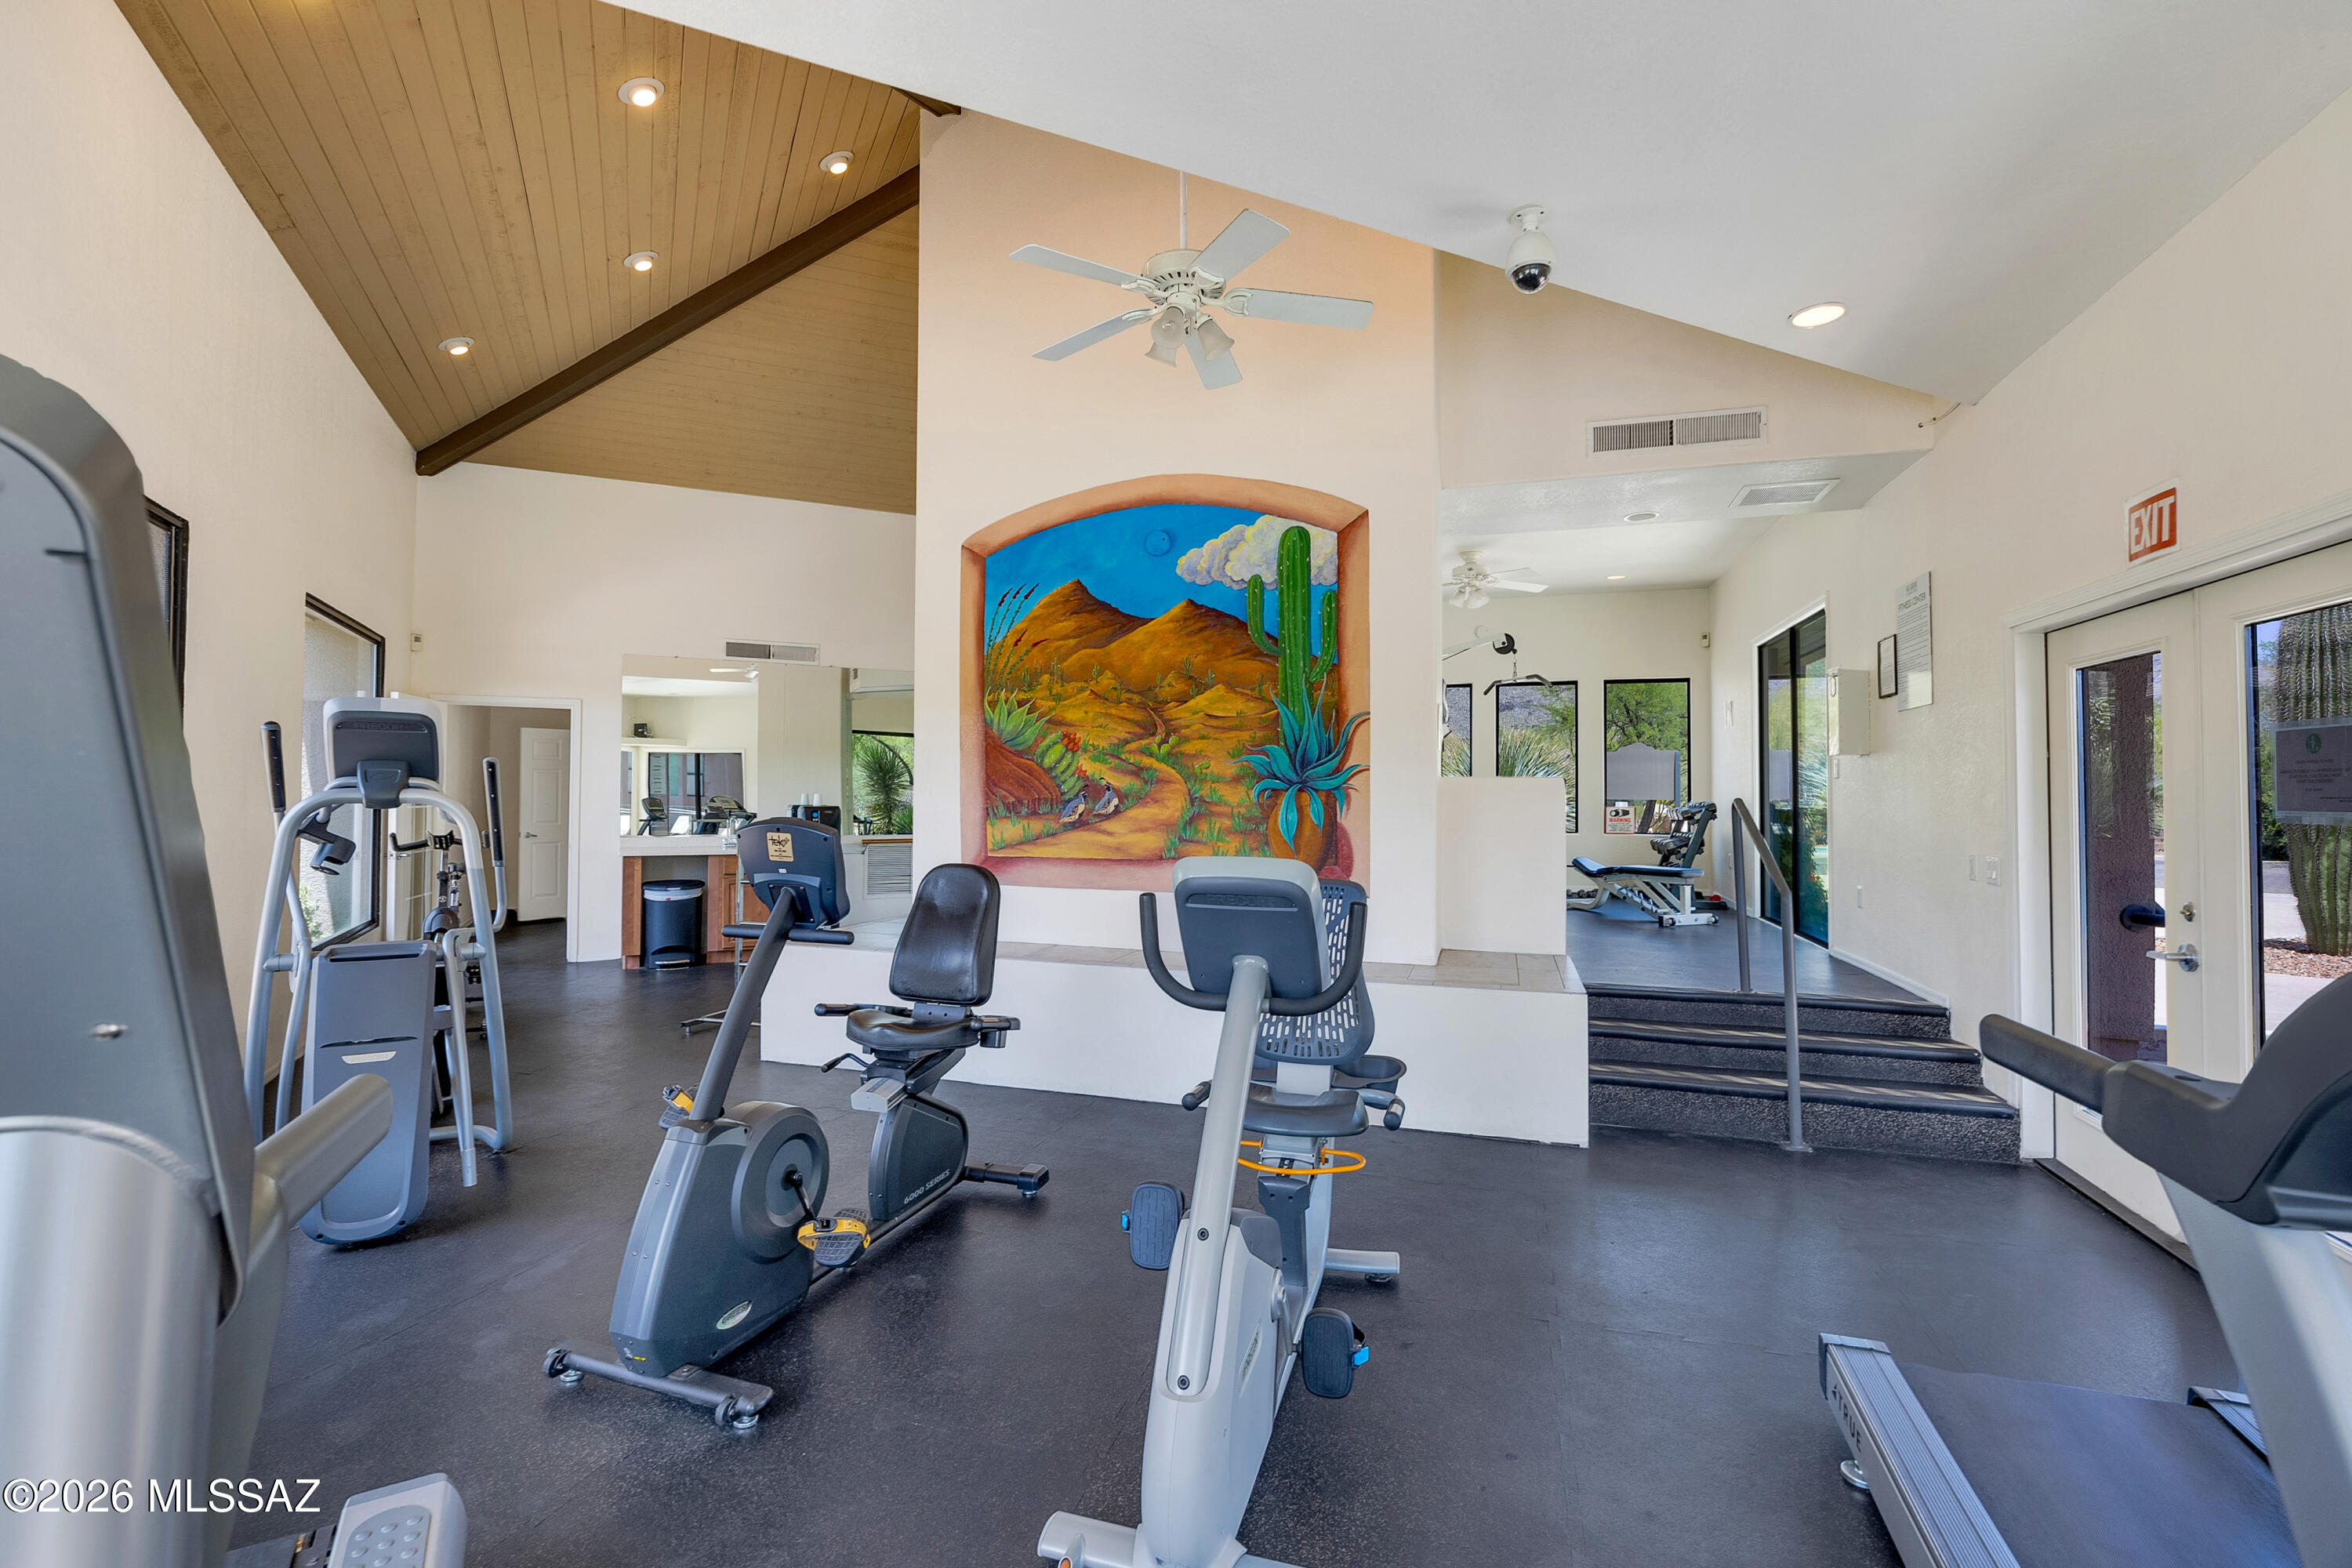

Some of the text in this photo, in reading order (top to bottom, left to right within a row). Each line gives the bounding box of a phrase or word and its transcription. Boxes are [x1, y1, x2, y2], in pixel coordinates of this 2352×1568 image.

[2130, 495, 2175, 555] EXIT
[904, 1168, 950, 1204] 6000 SERIES
[1838, 1391, 1861, 1453] TRUE
